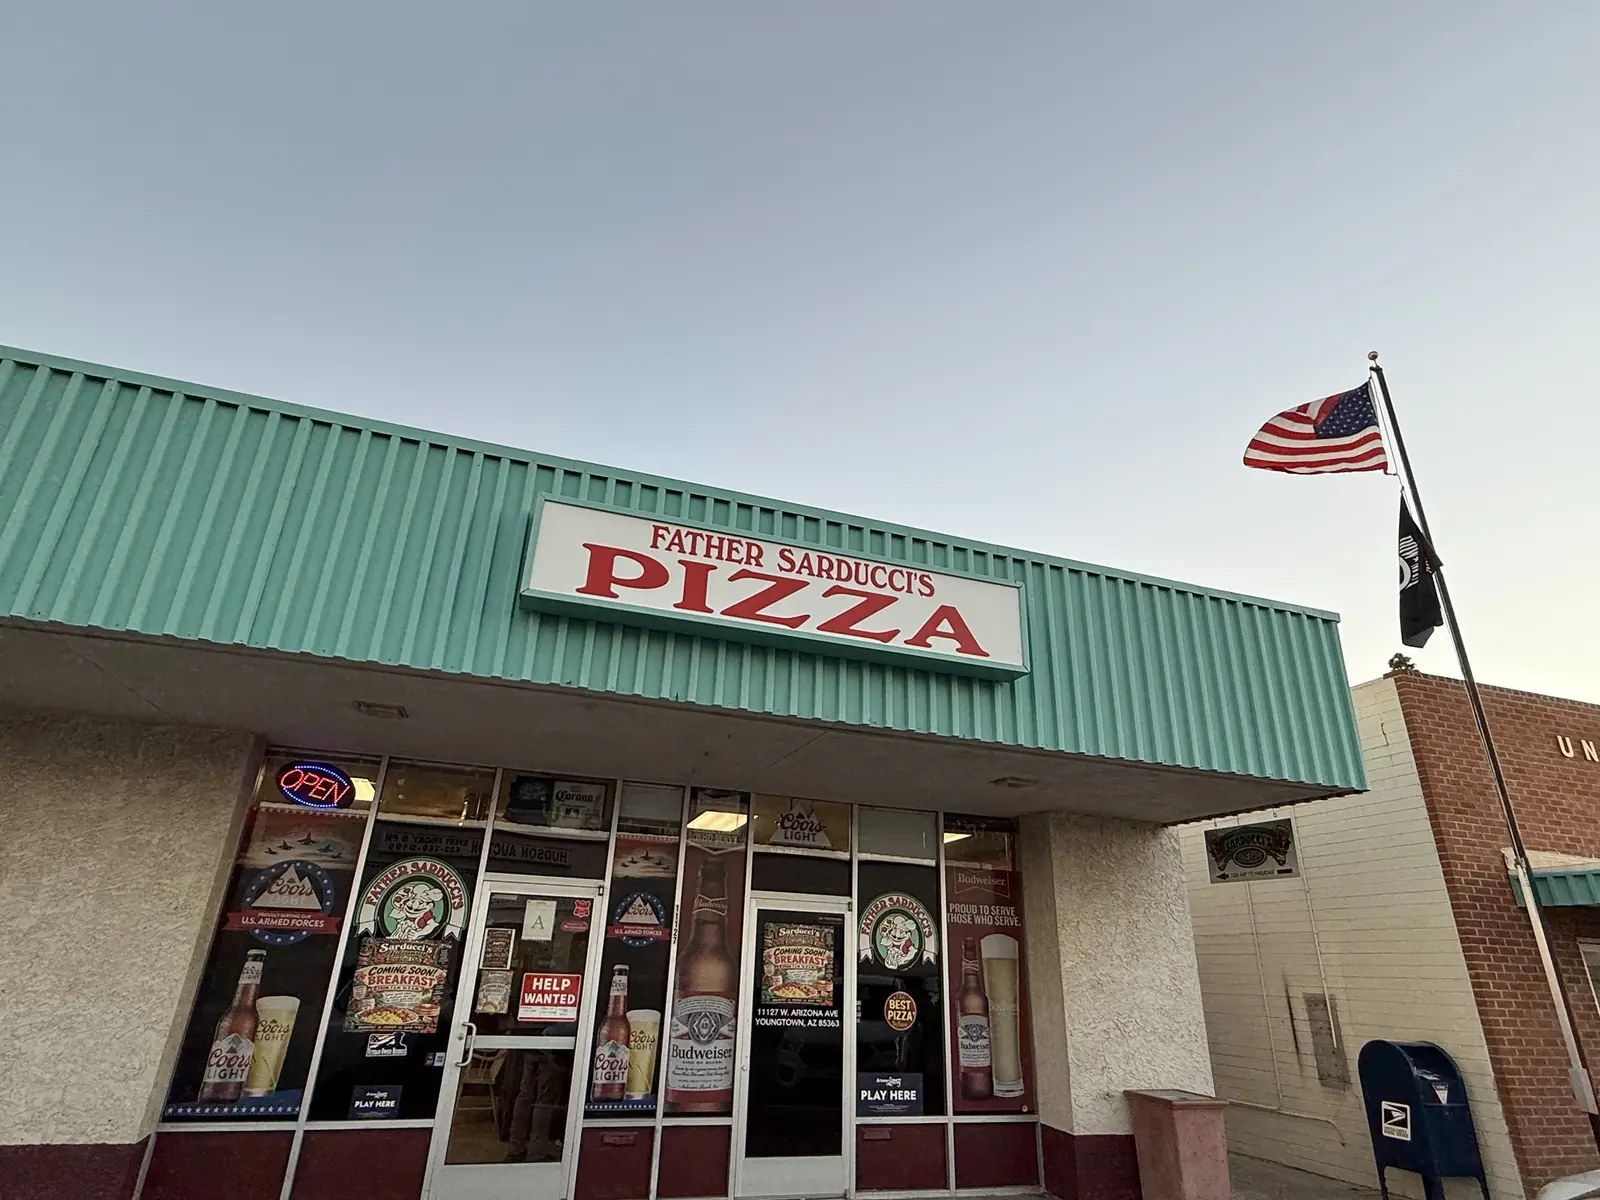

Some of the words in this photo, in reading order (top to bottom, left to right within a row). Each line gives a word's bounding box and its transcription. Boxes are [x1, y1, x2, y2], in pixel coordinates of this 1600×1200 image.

[650, 524, 764, 568] FATHER
[778, 548, 936, 598] SARDUCCI'S
[575, 542, 990, 657] PIZZA
[280, 768, 349, 804] OPEN
[556, 789, 594, 802] Corona
[780, 814, 826, 831] Coors
[784, 830, 816, 842] LIGHT
[958, 872, 1006, 886] Budweiser
[268, 878, 313, 896] Coors
[365, 865, 408, 906] FATHER
[411, 862, 464, 910] SARDUCCI'S
[627, 904, 654, 916] Coors
[949, 903, 978, 914] PROUD
[979, 904, 990, 914] TO
[990, 906, 1016, 916] SERVE
[241, 916, 256, 924] U.S.
[258, 918, 290, 926] ARMED
[290, 918, 324, 928] FORCES
[531, 914, 544, 930] A
[861, 900, 887, 935] FATHER
[887, 897, 932, 938] SARDUCCI'S
[974, 914, 993, 926] WHO
[994, 916, 1022, 926] SERVE.
[778, 928, 820, 937] Sarducci's
[379, 943, 433, 954] Sarducci's
[774, 948, 802, 956] COMING
[804, 948, 826, 957] SOON!
[774, 956, 825, 966] BREAKFAST
[368, 966, 406, 976] COMING
[410, 966, 438, 977] SOON!
[367, 975, 436, 987] BREAKFAST
[532, 978, 571, 990] HELP
[524, 993, 576, 1004] WANTED
[889, 999, 911, 1010] BEST
[758, 1008, 779, 1016] 11127
[824, 1010, 838, 1018] AVE
[888, 1010, 913, 1021] PIZZA
[256, 1020, 290, 1034] Coors
[756, 1018, 806, 1027] YOUNGTOWN,
[807, 1019, 817, 1027] AZ
[818, 1020, 840, 1028] 85363
[630, 1030, 656, 1044] Coors
[208, 1048, 250, 1068] Coors
[672, 1044, 732, 1060] Budweiser
[594, 1054, 628, 1070] Coors
[206, 1068, 246, 1080] LIGHT
[594, 1072, 626, 1081] LIGHT
[860, 1090, 887, 1101] PLAY
[890, 1090, 916, 1101] HERE
[354, 1100, 374, 1108] PLAY
[375, 1100, 396, 1108] HERE
